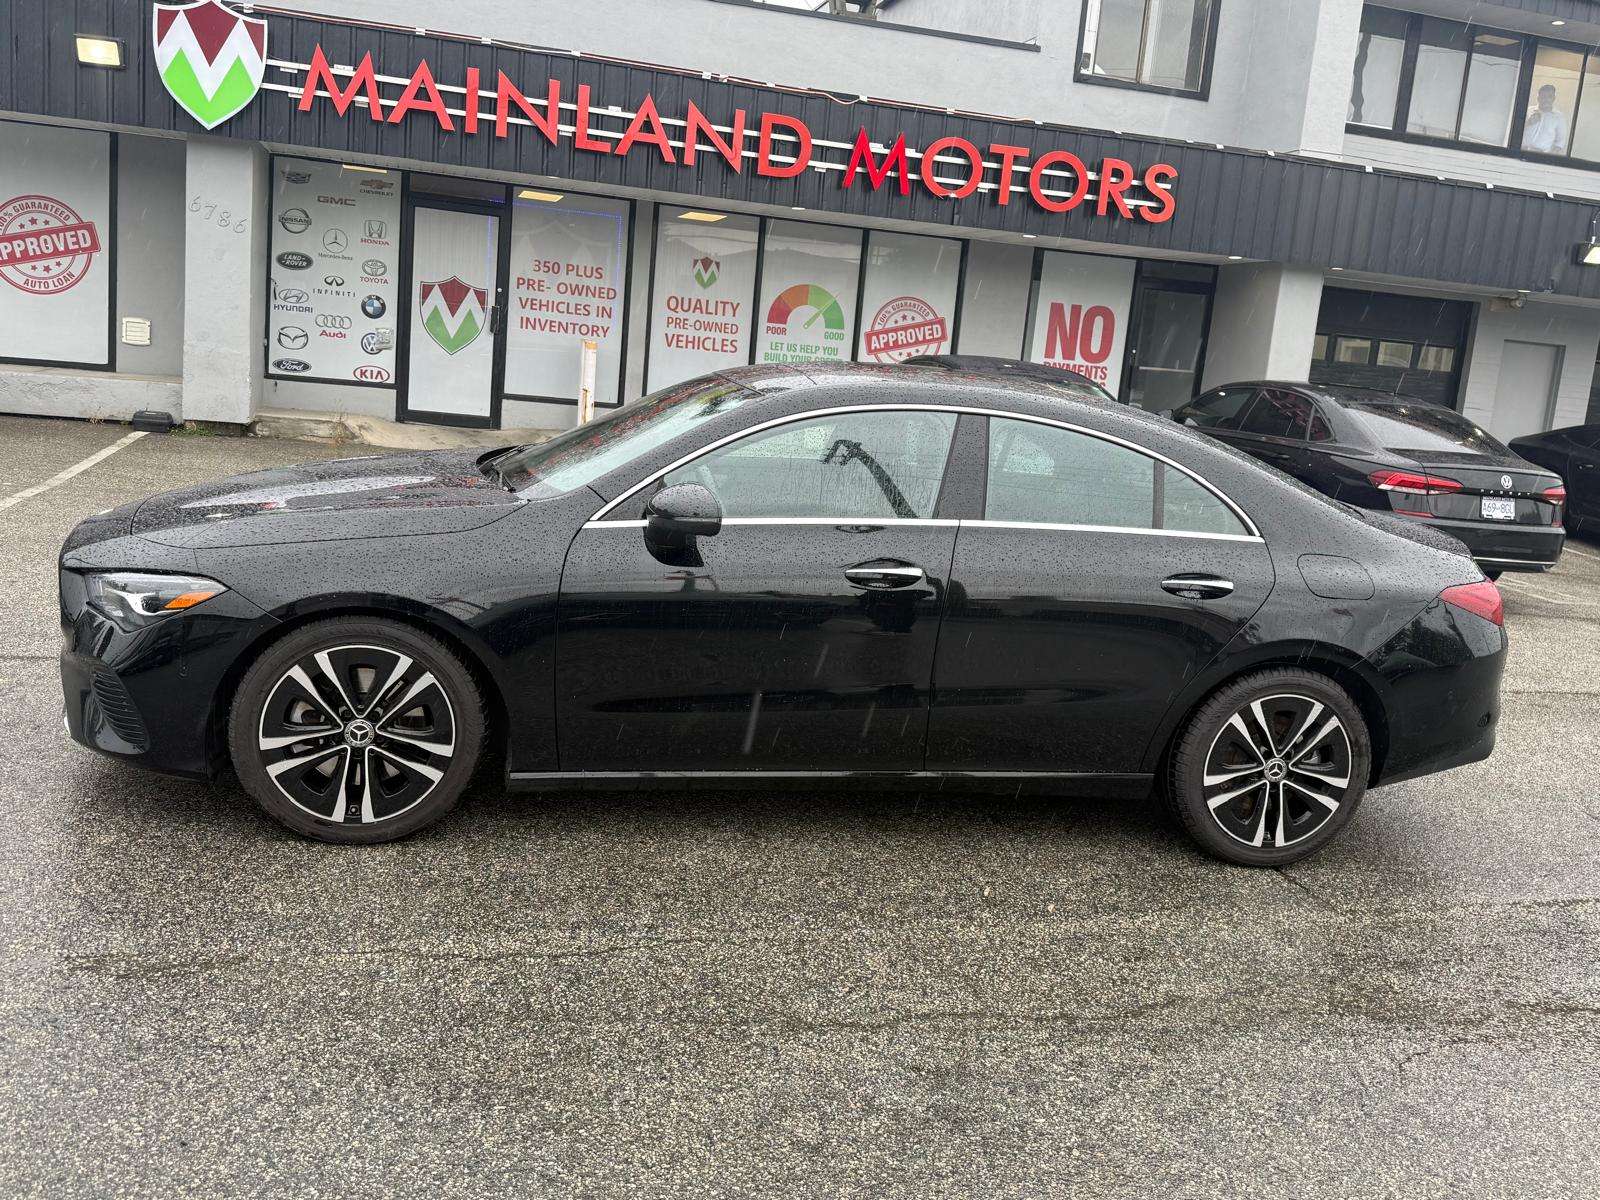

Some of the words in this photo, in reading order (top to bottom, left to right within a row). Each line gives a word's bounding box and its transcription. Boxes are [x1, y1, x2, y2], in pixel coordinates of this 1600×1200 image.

[298, 43, 813, 179] MAINLAND
[841, 125, 1179, 224] MOTORS
[317, 195, 356, 207] GMC
[13, 201, 71, 222] GUARANTEED
[189, 194, 248, 234] 6786
[281, 215, 311, 225] NISSAN
[0, 229, 91, 260] PPROVED
[360, 237, 390, 247] HONDA
[532, 259, 561, 275] 350
[565, 263, 604, 280] PLUS
[23, 278, 49, 289] AUTO
[53, 270, 76, 288] LOAN
[360, 276, 389, 285] TOYOTA
[516, 276, 551, 292] PRE-
[556, 281, 617, 300] OWNED
[312, 288, 357, 298] INFINITI
[273, 303, 313, 314] HYUNDAI
[518, 296, 591, 317] VEHICLES
[595, 305, 613, 320] IN
[666, 295, 741, 318] QUALITY
[891, 301, 931, 318] GUARANTEED
[319, 329, 347, 339] Audi
[519, 316, 610, 338] INVENTORY
[666, 316, 739, 335] PRE-OWNED
[765, 325, 787, 336] POOR
[1043, 302, 1116, 364] NO
[664, 332, 739, 354] VEHICLES
[870, 324, 942, 351] APPROVED
[763, 351, 788, 362] BUILD
[790, 354, 812, 363] YOUR
[770, 341, 785, 351] LET
[786, 343, 797, 353] US
[800, 344, 821, 355] HELP
[823, 346, 839, 356] YOU
[279, 360, 304, 371] Ford
[360, 368, 385, 381] KIA
